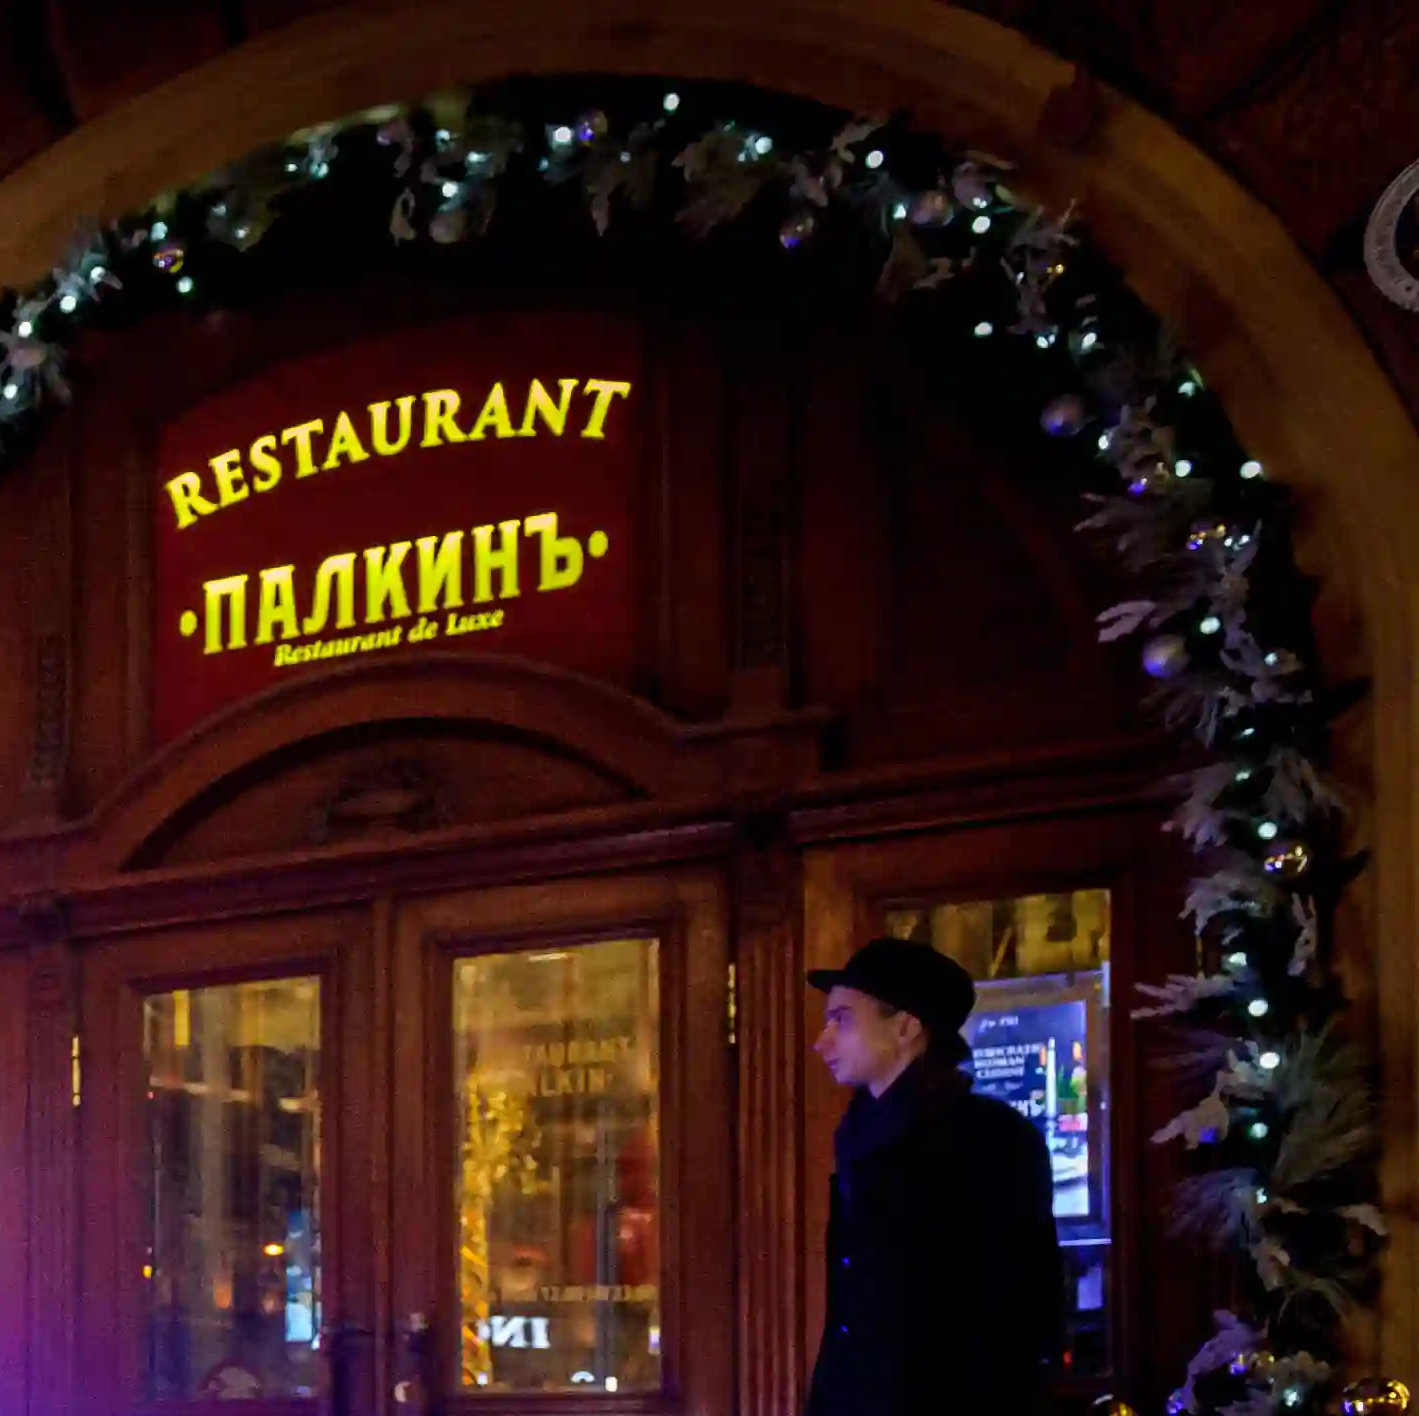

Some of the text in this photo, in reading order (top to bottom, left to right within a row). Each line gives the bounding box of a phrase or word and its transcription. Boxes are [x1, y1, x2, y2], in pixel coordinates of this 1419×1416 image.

[166, 378, 631, 529] RESTAURANT
[273, 608, 504, 667] Restaurant de Luxe
